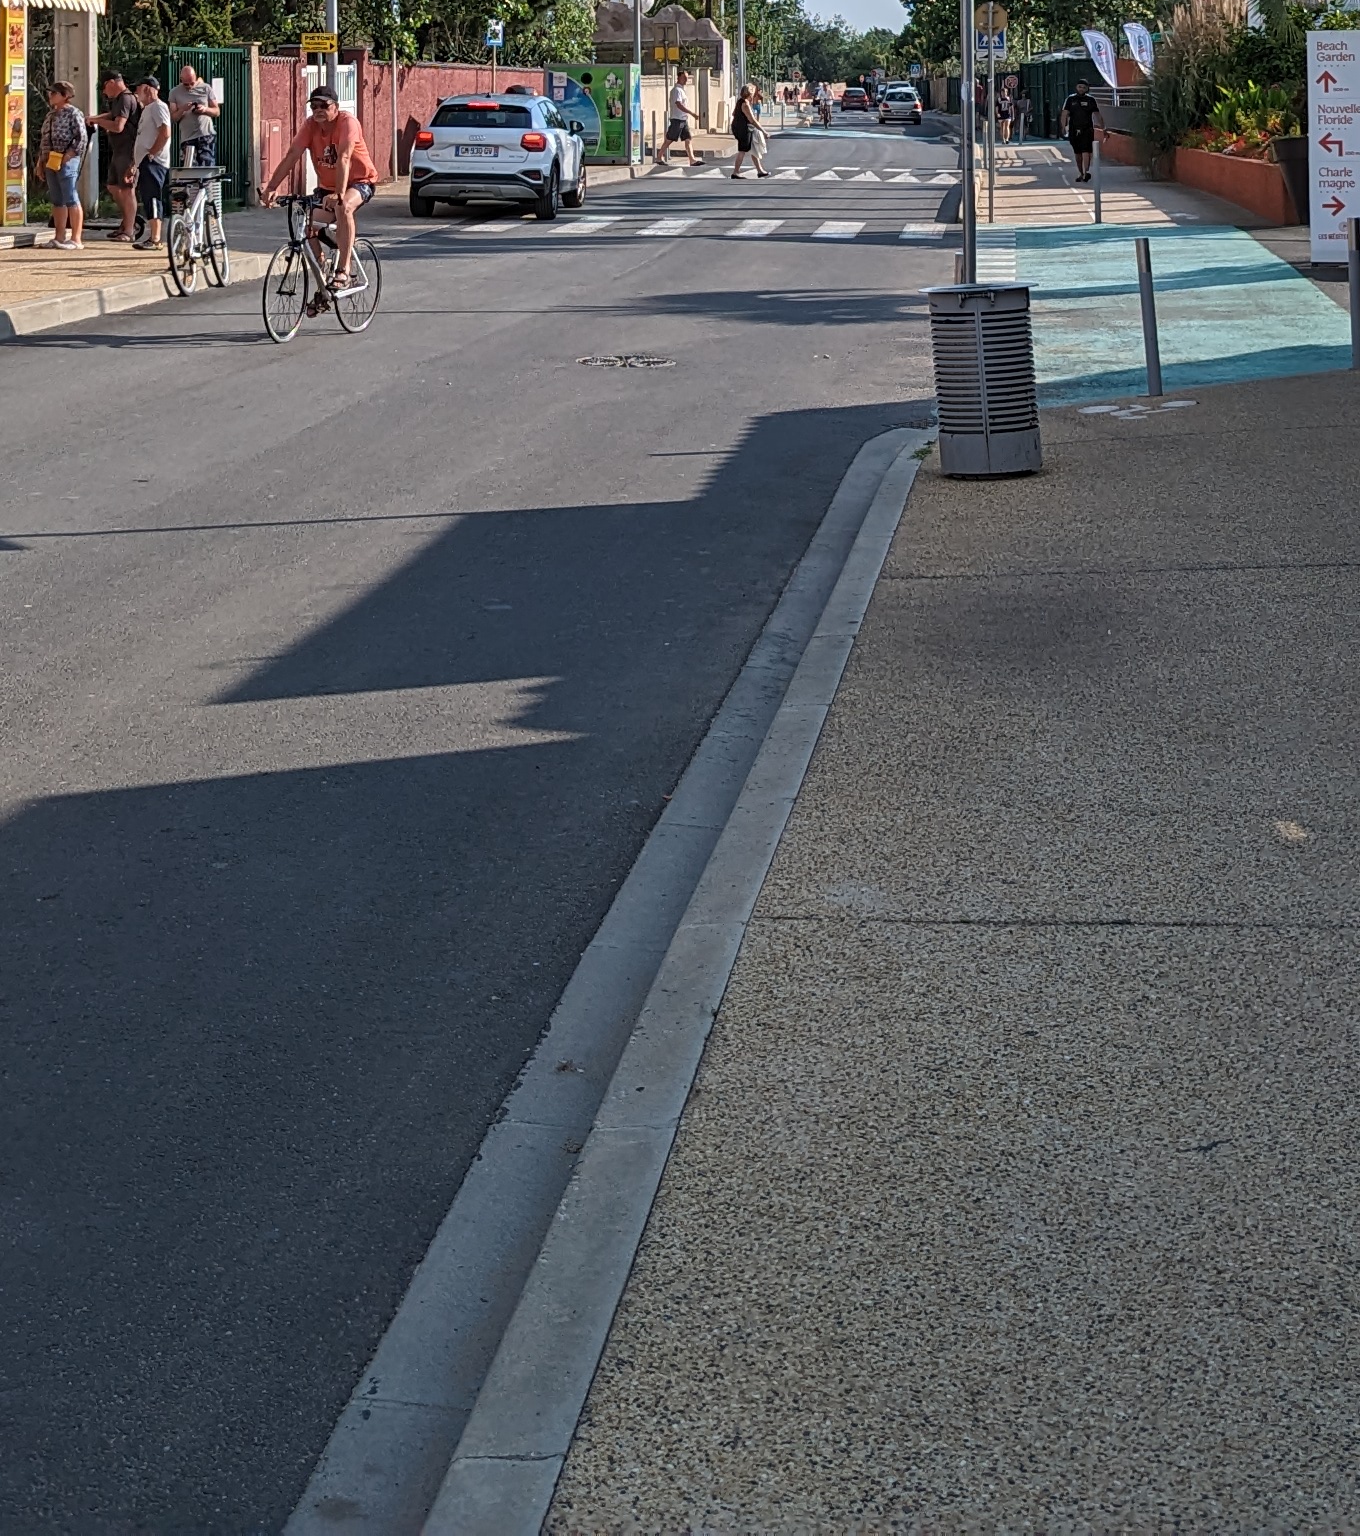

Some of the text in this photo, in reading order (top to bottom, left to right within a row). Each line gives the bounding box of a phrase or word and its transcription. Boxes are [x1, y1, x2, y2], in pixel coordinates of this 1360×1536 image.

[1316, 41, 1348, 52] Beach
[1316, 52, 1356, 63] Garden
[1317, 114, 1354, 125] Floride
[1318, 167, 1353, 177] Charle
[1318, 180, 1356, 191] magne
